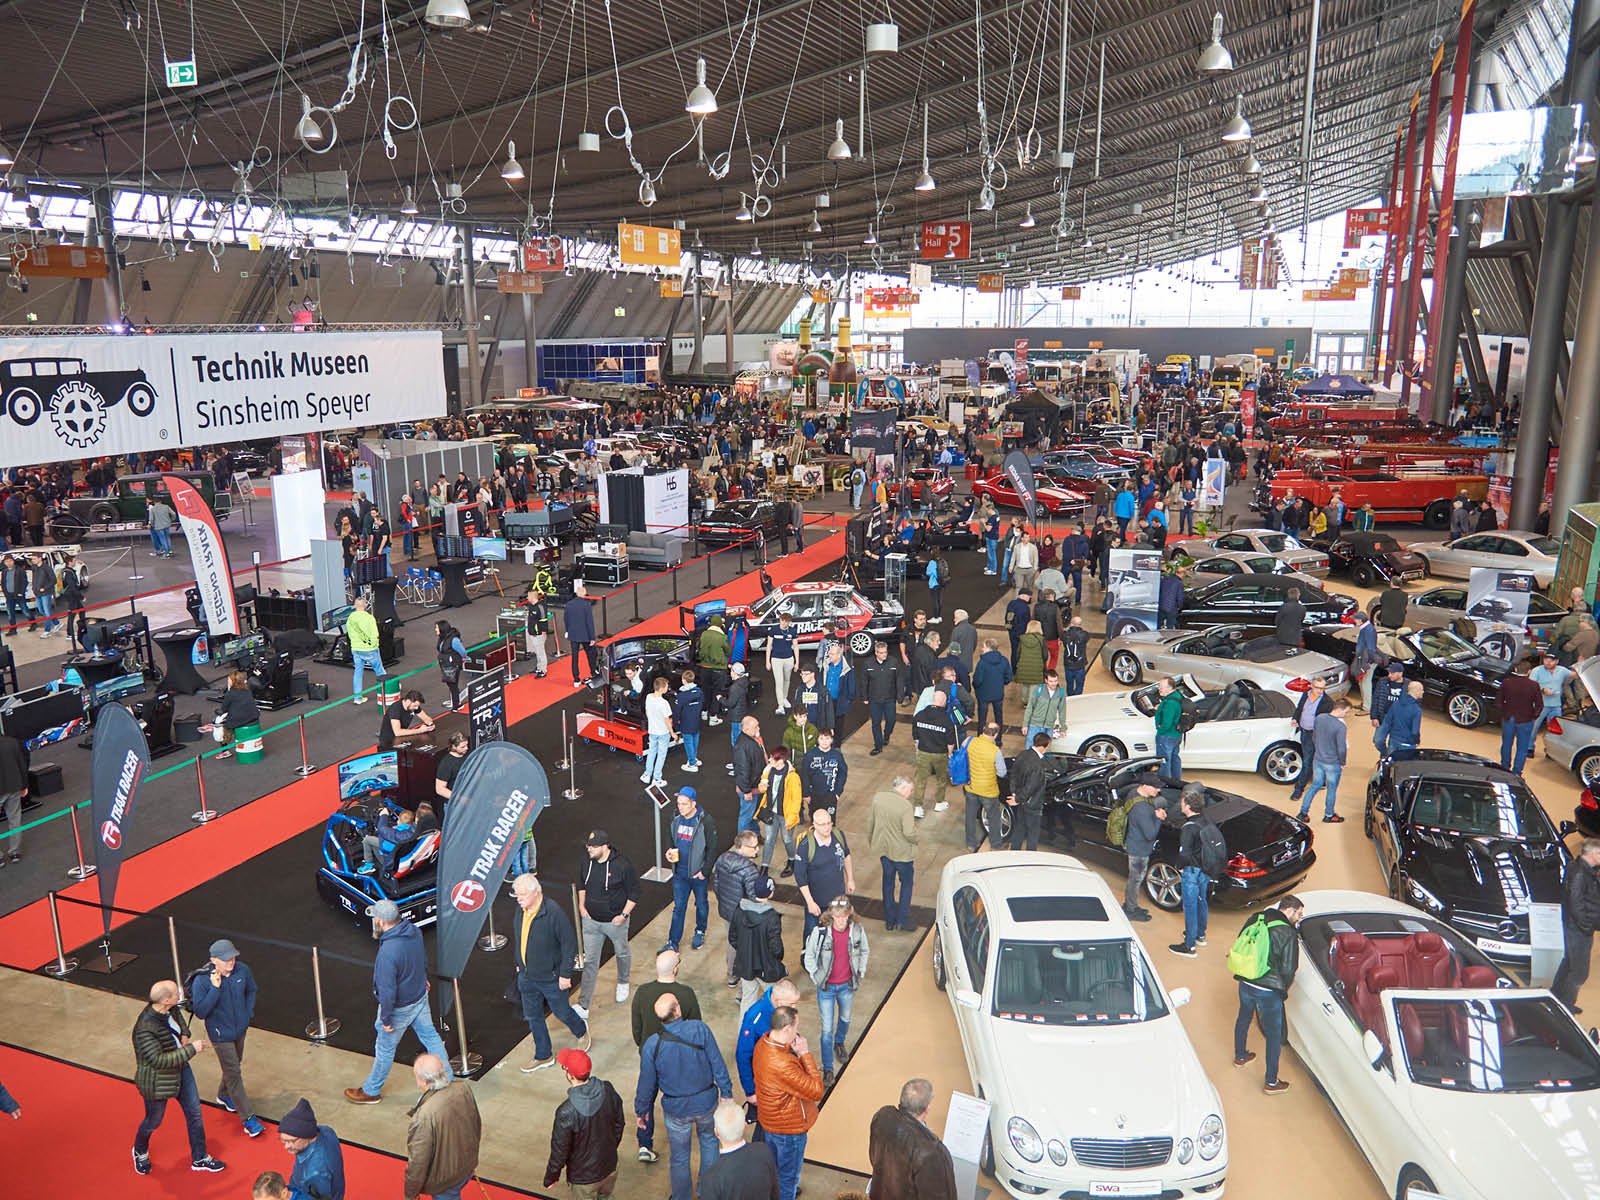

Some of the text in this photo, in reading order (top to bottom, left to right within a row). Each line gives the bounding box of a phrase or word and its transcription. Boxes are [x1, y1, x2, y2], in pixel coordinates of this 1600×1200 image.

[925, 238, 942, 247] Hall
[1349, 226, 1368, 236] Hall
[192, 350, 370, 383] Technik Museen
[197, 392, 372, 429] Sinsheim Speyer
[472, 702, 502, 725] TRX
[118, 749, 139, 795] RACER
[110, 787, 128, 824] TRAK
[470, 837, 503, 880] TRAK
[491, 789, 529, 842] RACER
[1095, 1184, 1120, 1193] swa
